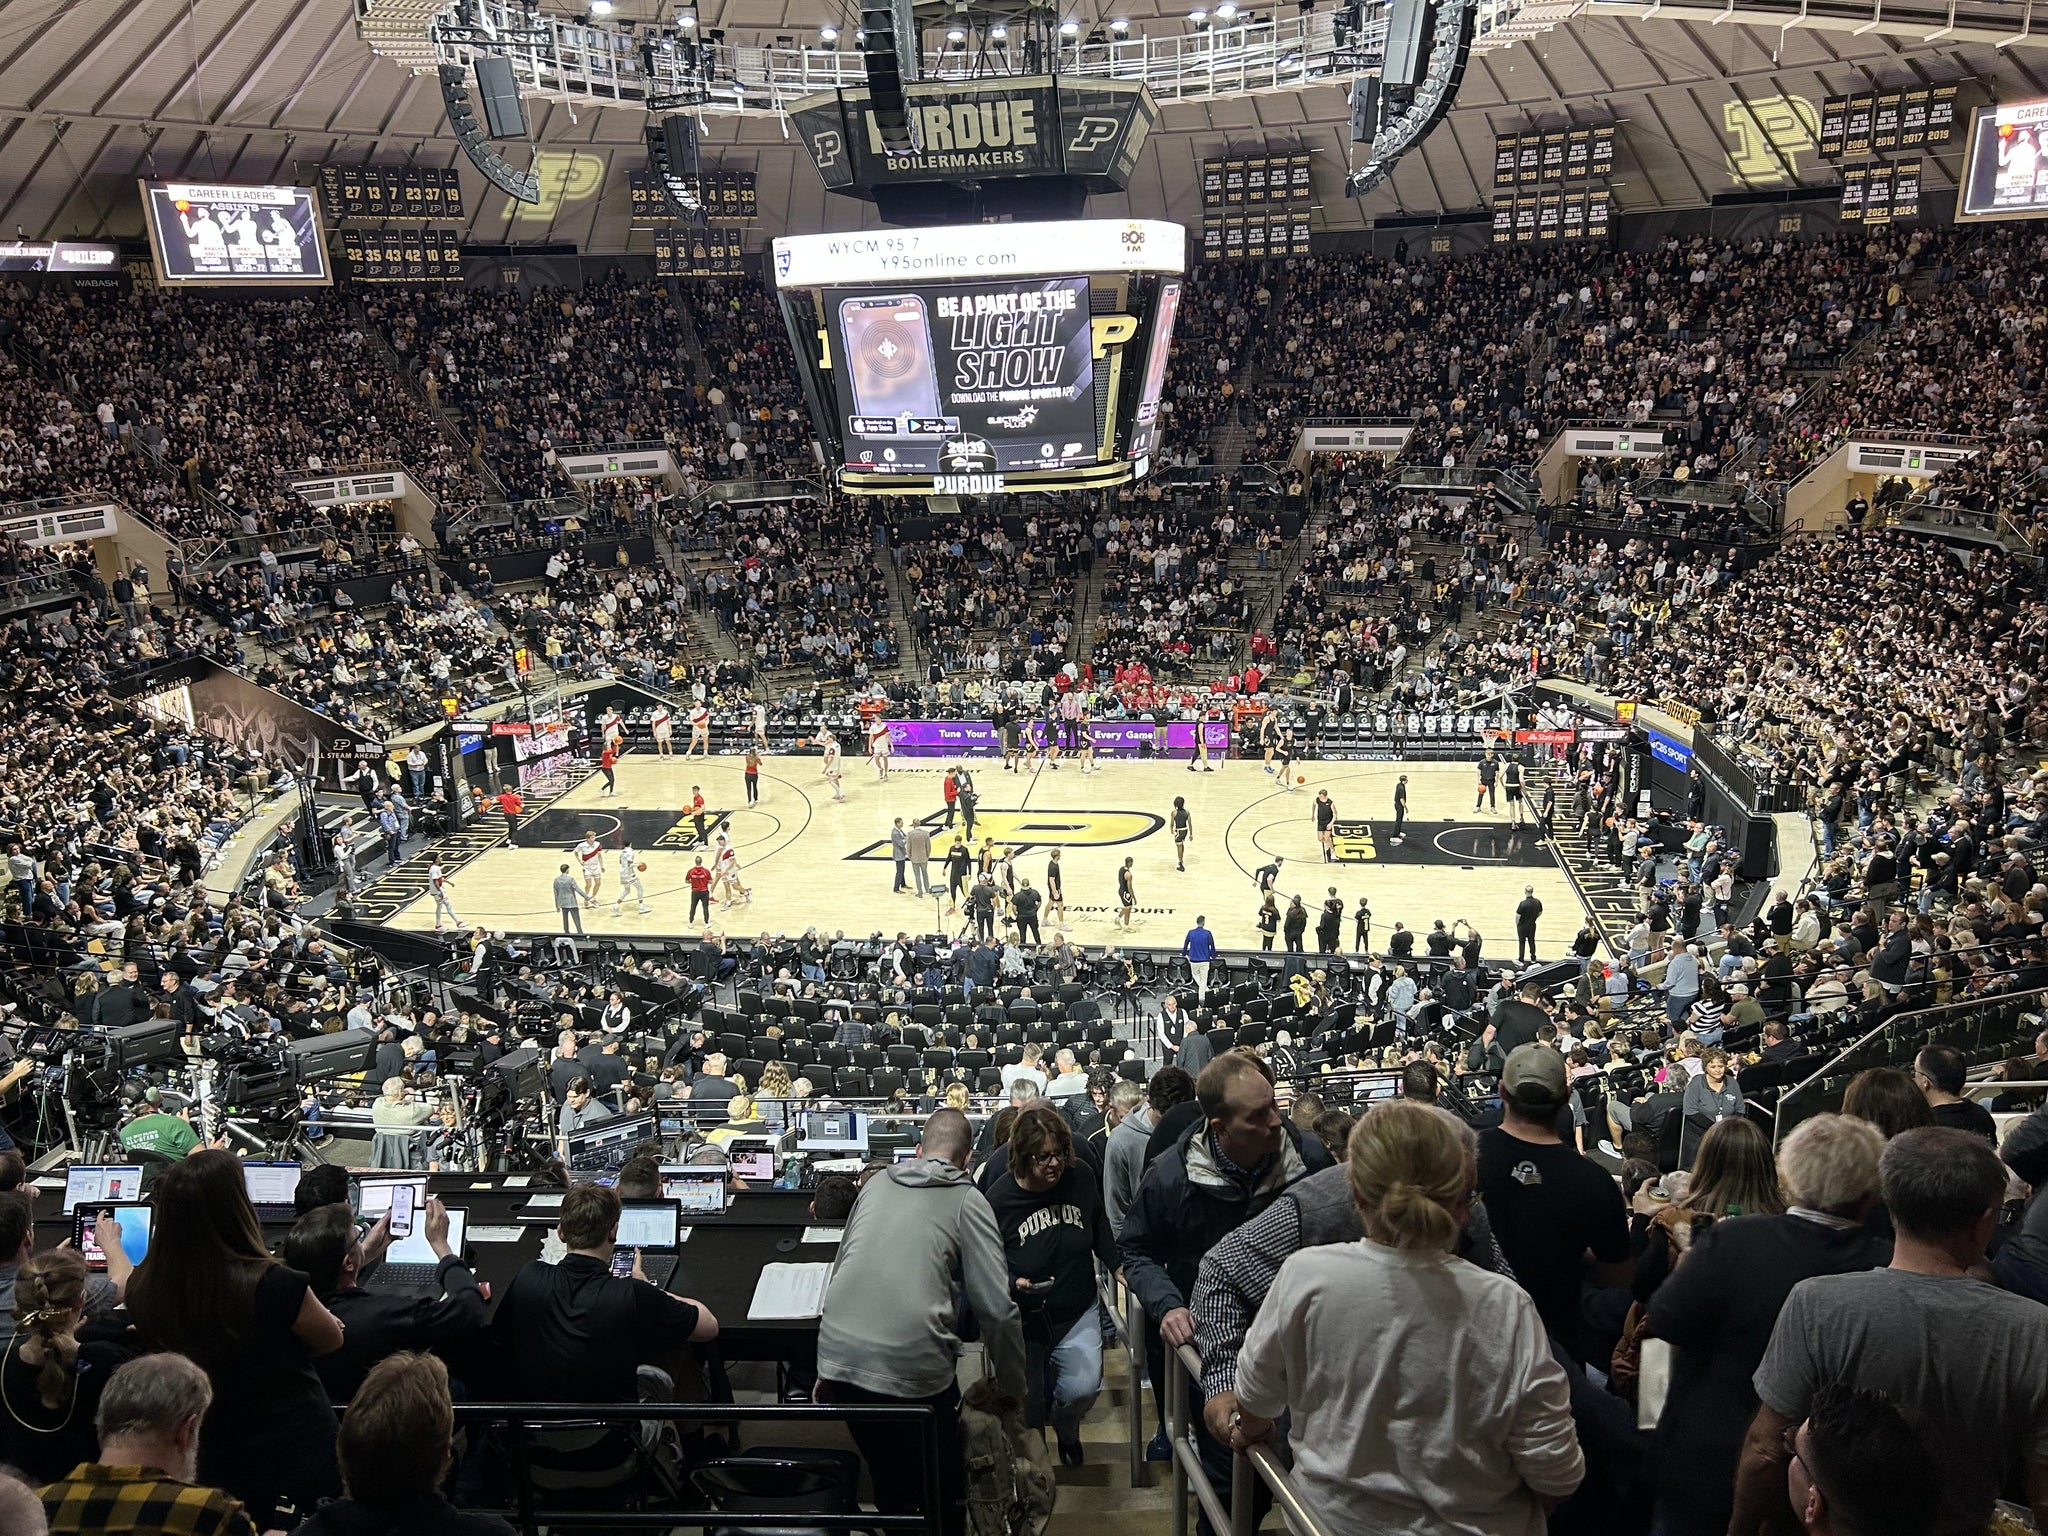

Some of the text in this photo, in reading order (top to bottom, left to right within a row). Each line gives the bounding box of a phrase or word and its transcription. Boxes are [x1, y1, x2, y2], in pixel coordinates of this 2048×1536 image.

[1906, 91, 1928, 100] PURDUE
[1933, 87, 1957, 96] PURDUE
[1851, 98, 1872, 106] PURDUE
[1878, 95, 1900, 103] PURDUE
[1825, 102, 1846, 110] PURDUE
[865, 100, 1037, 154] URDUE
[1069, 117, 1119, 152] P
[1903, 133, 1924, 143] 2017
[1928, 130, 1949, 140] 2019
[1847, 139, 1868, 149] 2009
[1876, 136, 1895, 146] 2010
[814, 131, 841, 168] P
[1822, 143, 1840, 152] 1996
[887, 150, 1024, 170] BOILERMAKERS
[1898, 164, 1920, 172] PURDUE
[189, 189, 276, 200] CAREER LEADERS
[345, 186, 361, 199] 27
[367, 186, 380, 199] 13
[389, 187, 398, 200] 7
[406, 188, 422, 200] 23
[425, 188, 440, 200] 37
[446, 188, 458, 200] 19
[632, 190, 647, 201] 23
[709, 190, 716, 201] 4
[724, 190, 737, 201] 25
[741, 190, 754, 201] 33
[210, 202, 259, 212] ASSISTS
[1867, 208, 1888, 216] 2023
[1893, 206, 1917, 215] 2024
[1842, 210, 1861, 219] 2023
[1779, 219, 1801, 232] 103
[1122, 231, 1145, 244] BOB
[656, 247, 670, 257] 50
[678, 247, 685, 257] 3
[710, 247, 724, 257] 23
[728, 246, 740, 256] 15
[828, 240, 879, 254] WYCM
[1431, 240, 1449, 252] 102
[348, 249, 364, 261] 32
[366, 249, 382, 261] 35
[385, 250, 401, 261] 43
[405, 250, 421, 262] 42
[426, 250, 438, 261] 10
[444, 250, 459, 262] 22
[503, 270, 520, 283] 117
[937, 290, 1076, 317] BE A PART OF THE
[951, 307, 1063, 350] LIGHT
[955, 346, 1065, 389] SHOW
[951, 392, 985, 403] DOWNLOAD
[986, 391, 998, 401] THE
[1062, 386, 1074, 396] APP
[924, 424, 943, 432] Google
[884, 448, 896, 461] 0
[1041, 444, 1054, 457] 0
[934, 474, 1005, 494] PURDUE
[168, 677, 192, 690] HARD
[1667, 700, 1692, 724] DEFENSE
[966, 730, 987, 738] Your
[1095, 731, 1156, 740] Every Game!
[333, 739, 350, 750] P
[1656, 741, 1668, 755] CBS
[842, 809, 1166, 862] P
[1332, 824, 1376, 859] BIG
[1018, 1204, 1084, 1246] PURDUE
